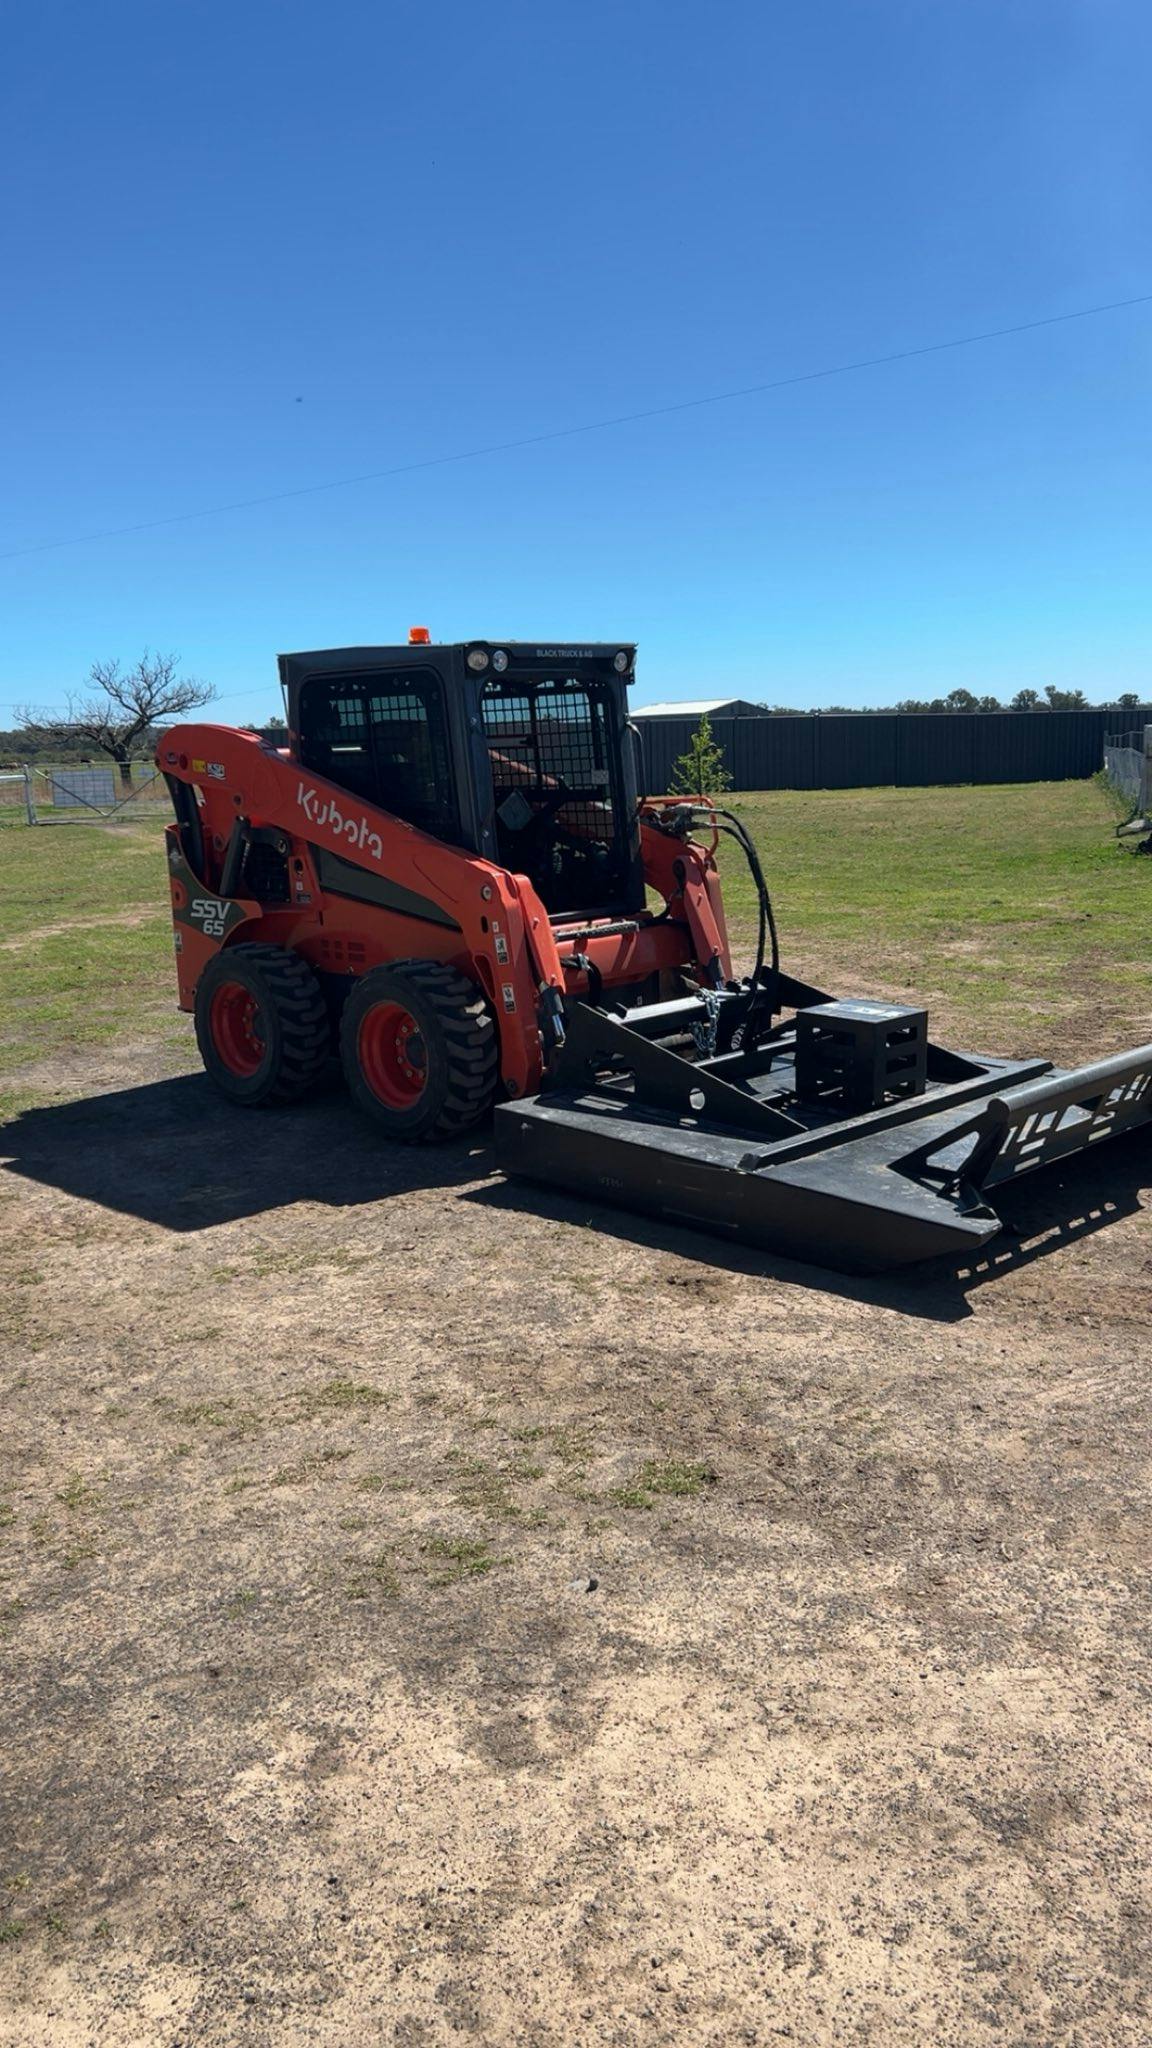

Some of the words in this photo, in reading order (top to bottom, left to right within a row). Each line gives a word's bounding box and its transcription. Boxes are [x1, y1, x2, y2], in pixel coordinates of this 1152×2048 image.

[297, 782, 383, 860] Kubota
[190, 899, 231, 920] SSV
[202, 919, 225, 936] 65
